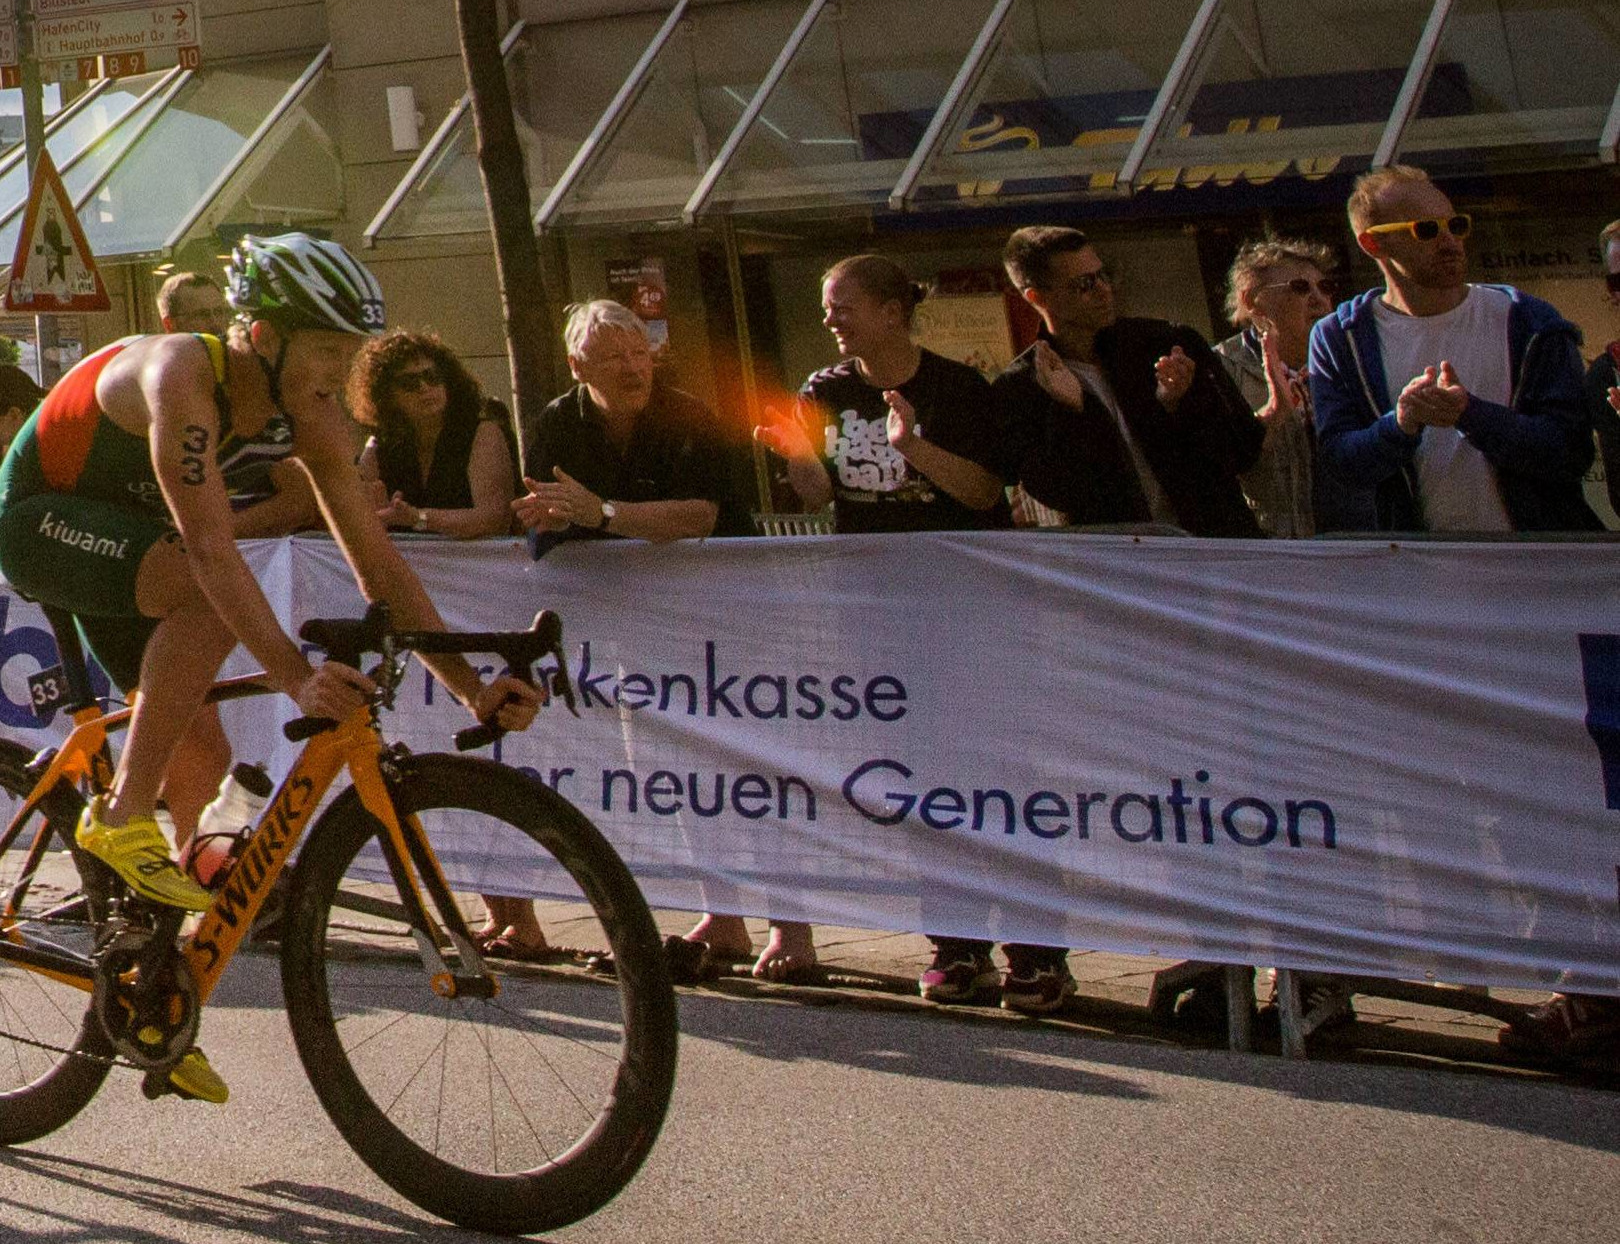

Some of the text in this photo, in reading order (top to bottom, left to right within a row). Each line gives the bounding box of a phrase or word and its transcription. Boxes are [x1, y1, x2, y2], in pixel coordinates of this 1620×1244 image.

[41, 19, 101, 38] HafenCity
[59, 33, 146, 53] Hauptbahnhof
[83, 60, 93, 78] 7
[110, 58, 120, 76] 8
[129, 55, 140, 74] 9
[179, 49, 198, 68] 10
[362, 303, 385, 325] 33
[181, 424, 210, 487] 33
[38, 511, 130, 561] kiwami
[33, 678, 58, 707] 33
[601, 769, 817, 821] neuen
[841, 758, 1338, 850] Generation
[191, 775, 313, 973] S-WORKS
